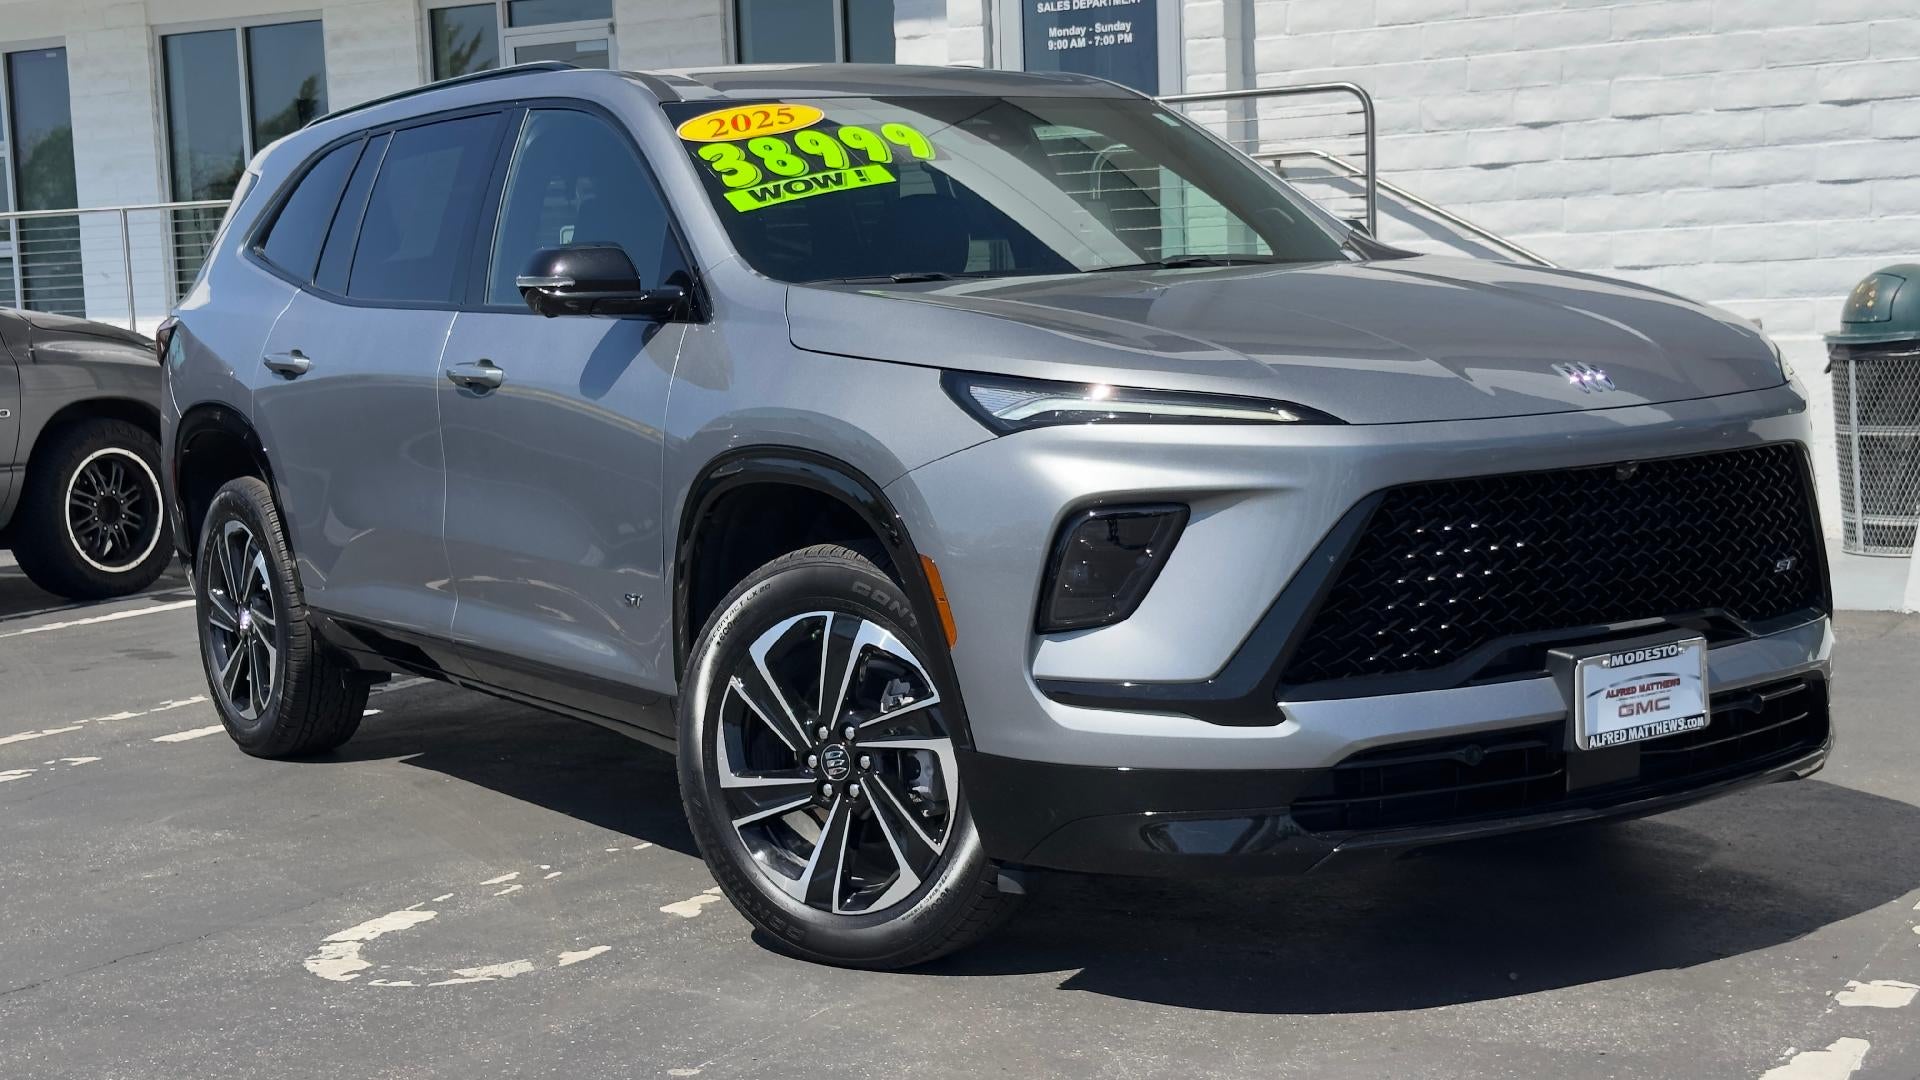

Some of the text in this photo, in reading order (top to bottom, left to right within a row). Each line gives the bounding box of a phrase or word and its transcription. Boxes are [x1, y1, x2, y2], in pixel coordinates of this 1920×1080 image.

[1037, 1, 1071, 13] SALES
[1048, 25, 1086, 37] Monday
[1094, 20, 1132, 33] Sunday
[1047, 38, 1068, 50] 9:00
[1070, 37, 1086, 48] AM
[1094, 35, 1114, 47] 7:00
[1117, 33, 1132, 44] PM
[706, 107, 796, 138] 2025
[697, 122, 936, 188] 38999
[748, 171, 848, 203] WOW
[1610, 645, 1678, 667] MODESTO
[1605, 686, 1637, 699] ALFRED
[1638, 678, 1681, 693] MATTHEWS
[1618, 696, 1671, 718] GMC
[1589, 729, 1627, 749] ALFRED
